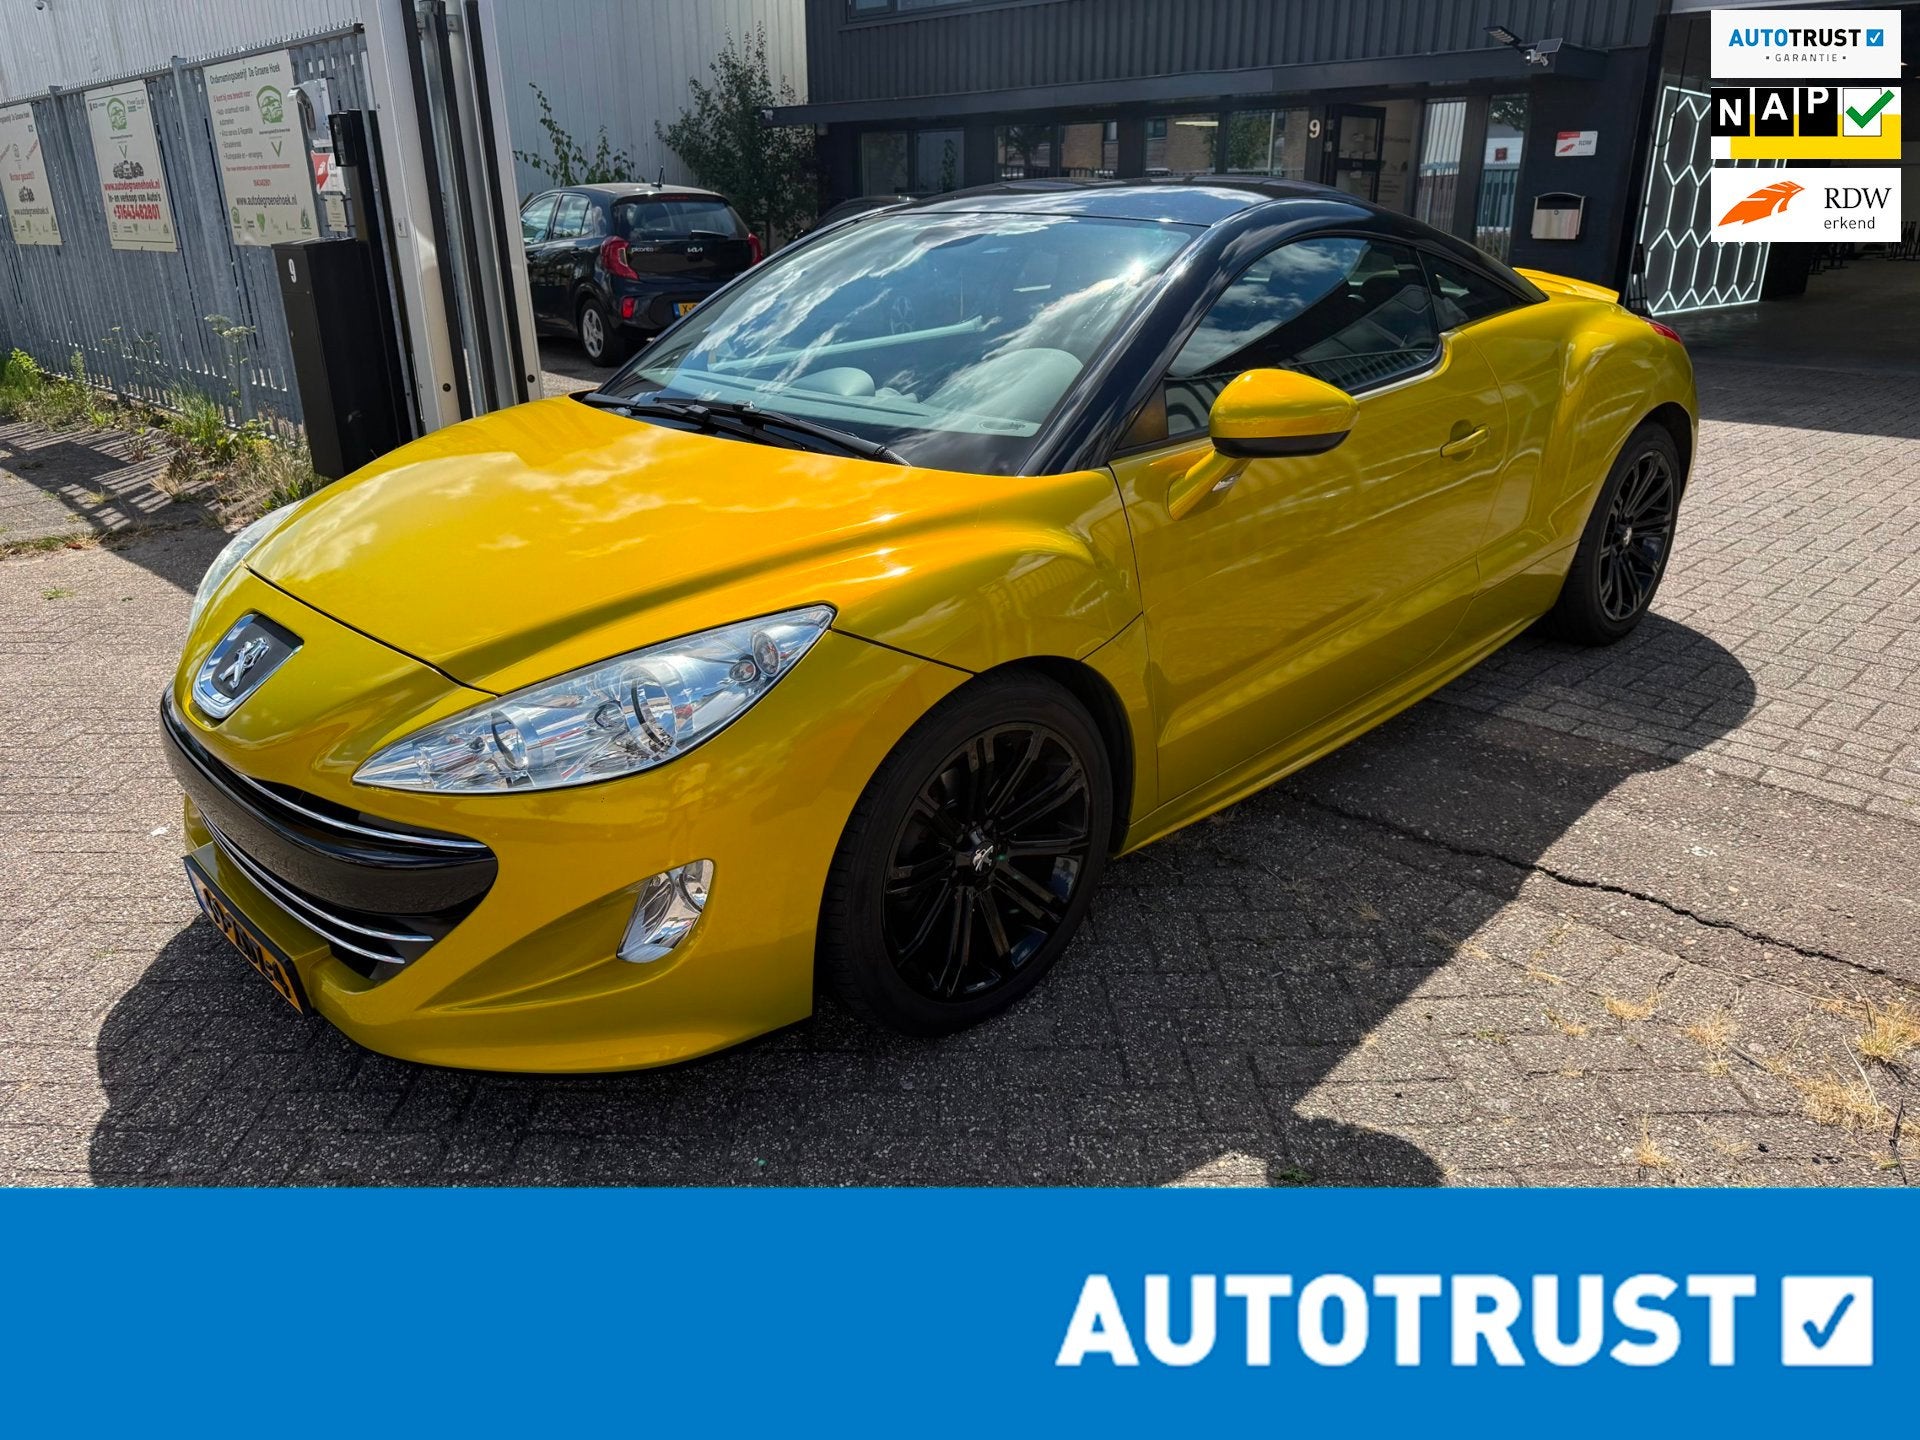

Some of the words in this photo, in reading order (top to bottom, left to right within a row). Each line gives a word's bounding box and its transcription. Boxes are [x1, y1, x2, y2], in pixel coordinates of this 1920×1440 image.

[269, 63, 280, 73] Hoek
[1309, 119, 1320, 138] 9
[236, 194, 297, 208] www.autodegroenehoek.nl
[288, 258, 297, 283] 9
